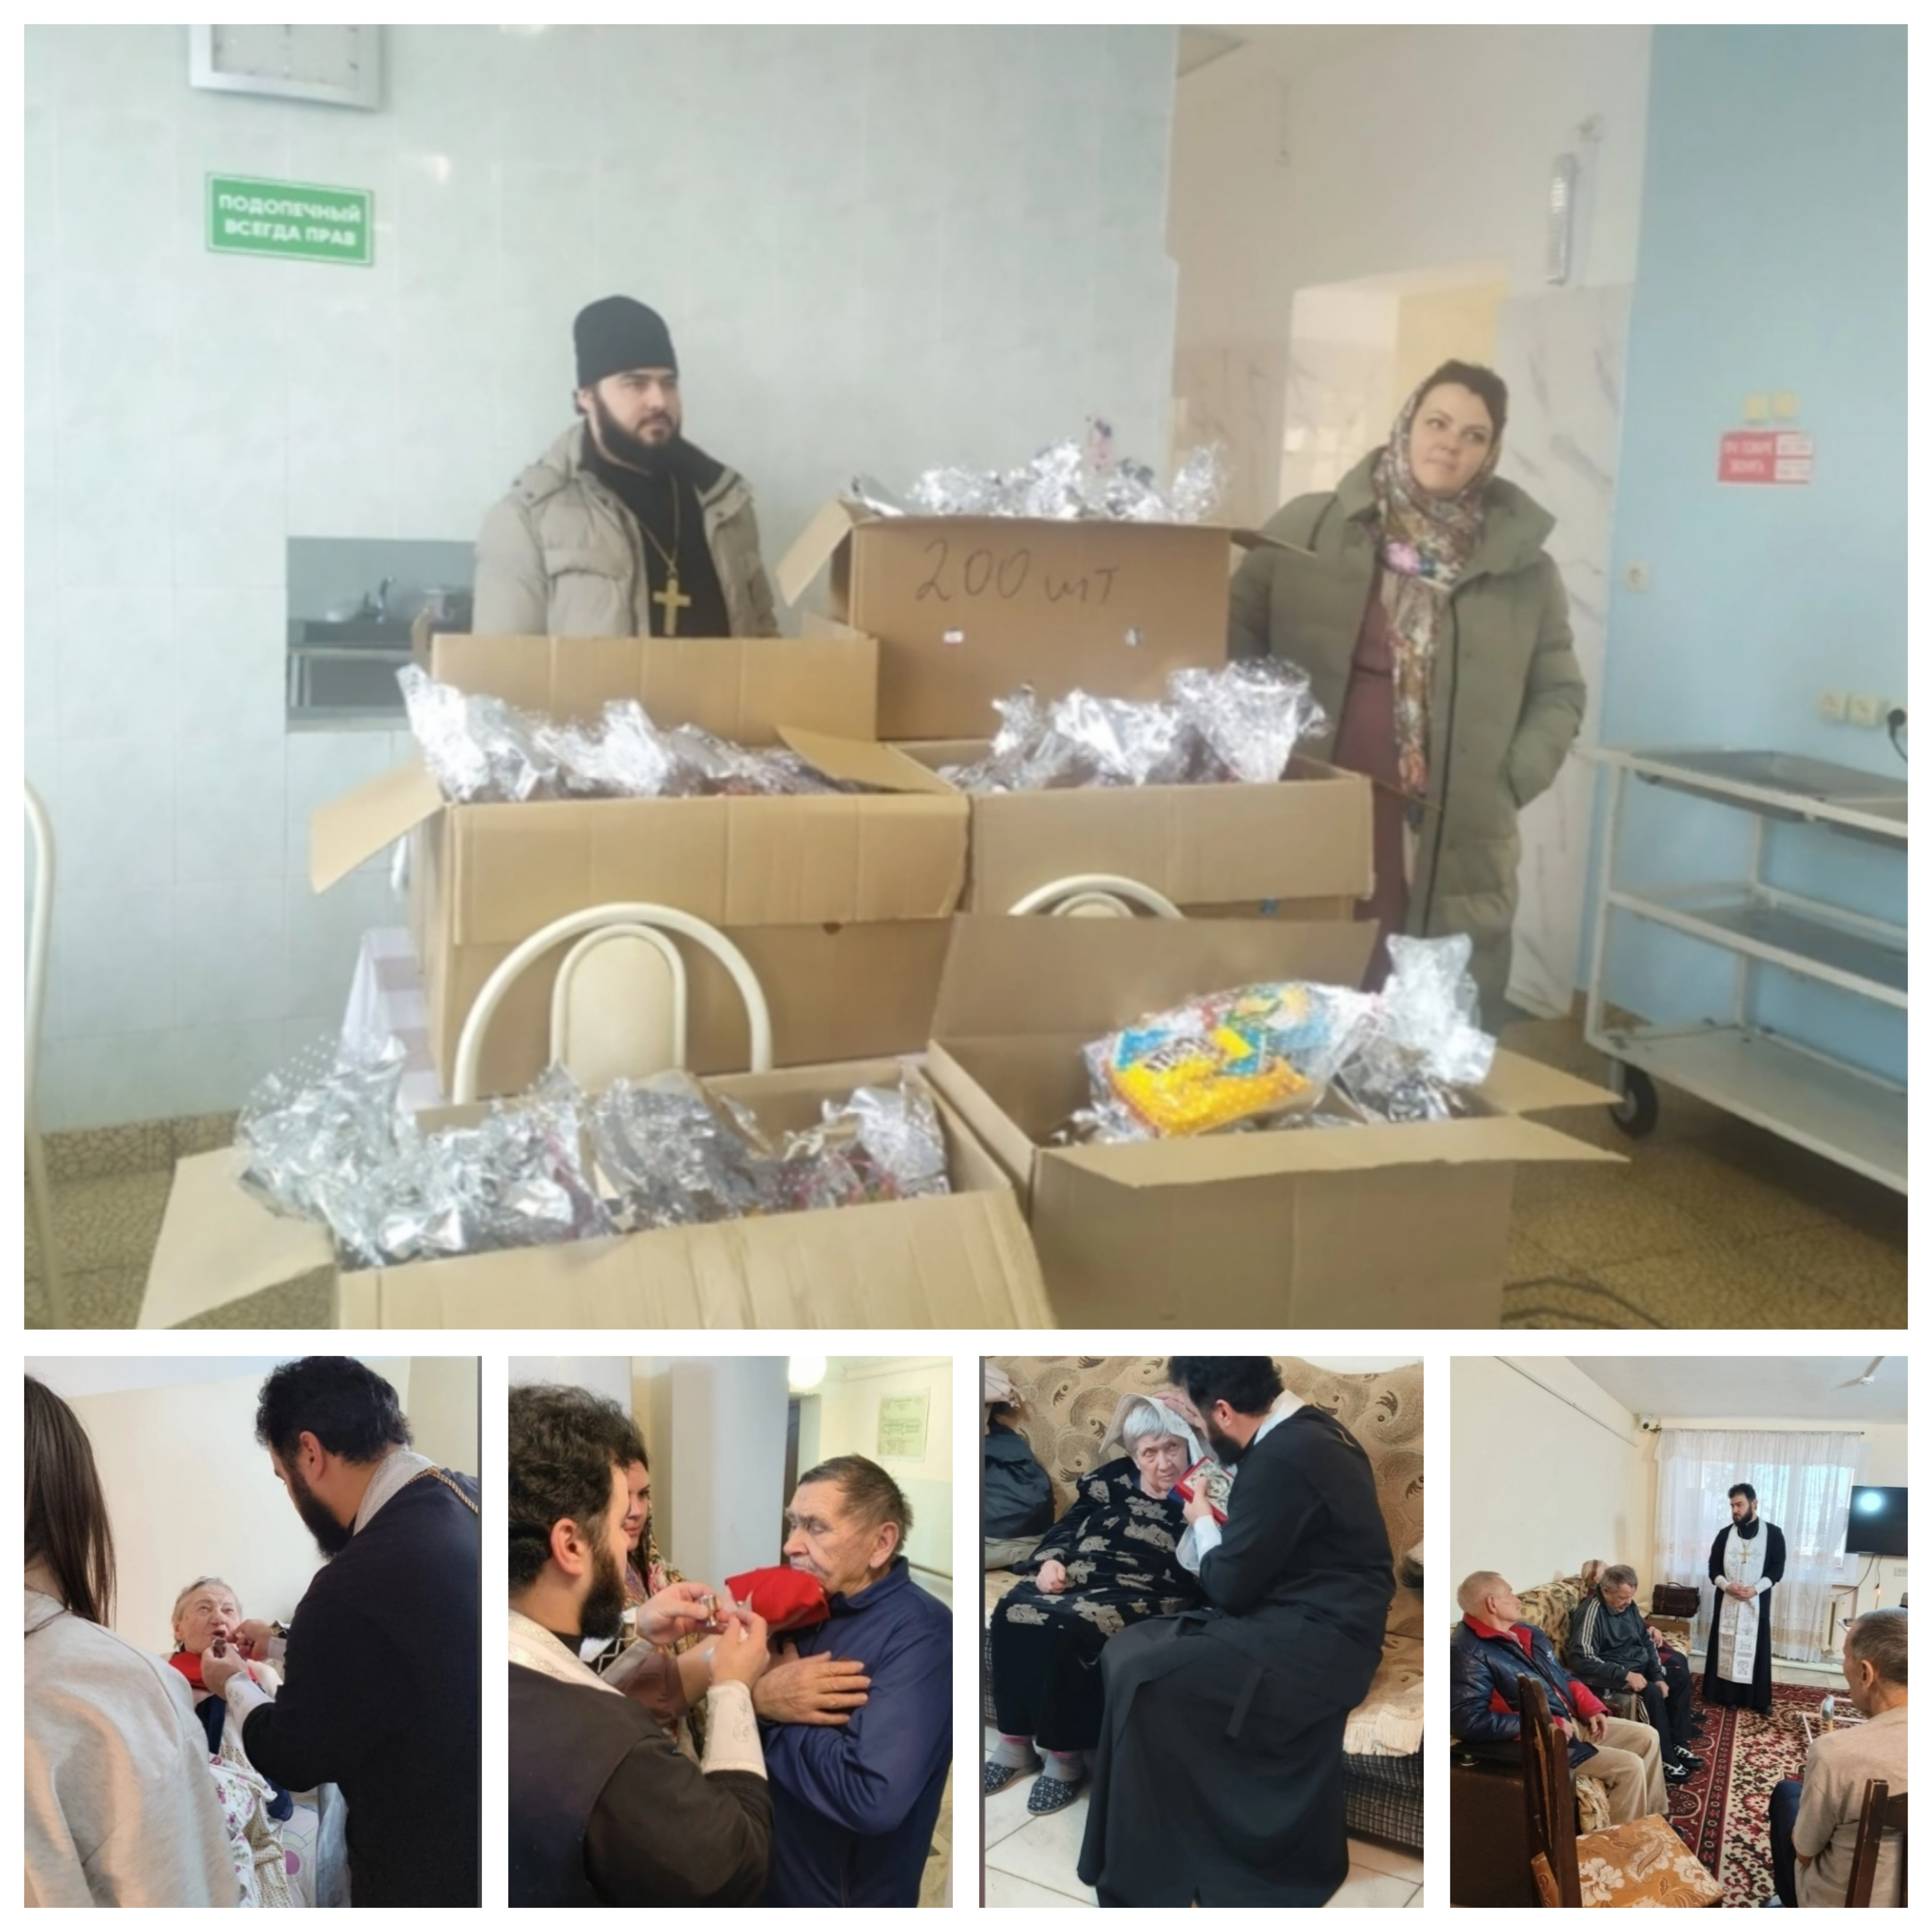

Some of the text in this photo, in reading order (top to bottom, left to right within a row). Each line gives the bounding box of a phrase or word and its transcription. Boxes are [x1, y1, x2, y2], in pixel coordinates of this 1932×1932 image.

[218, 193, 361, 224] ПОДОПЕЧНЫЙ
[224, 218, 357, 247] ВСЕГДА ПРАВ
[916, 537, 1030, 601] 200
